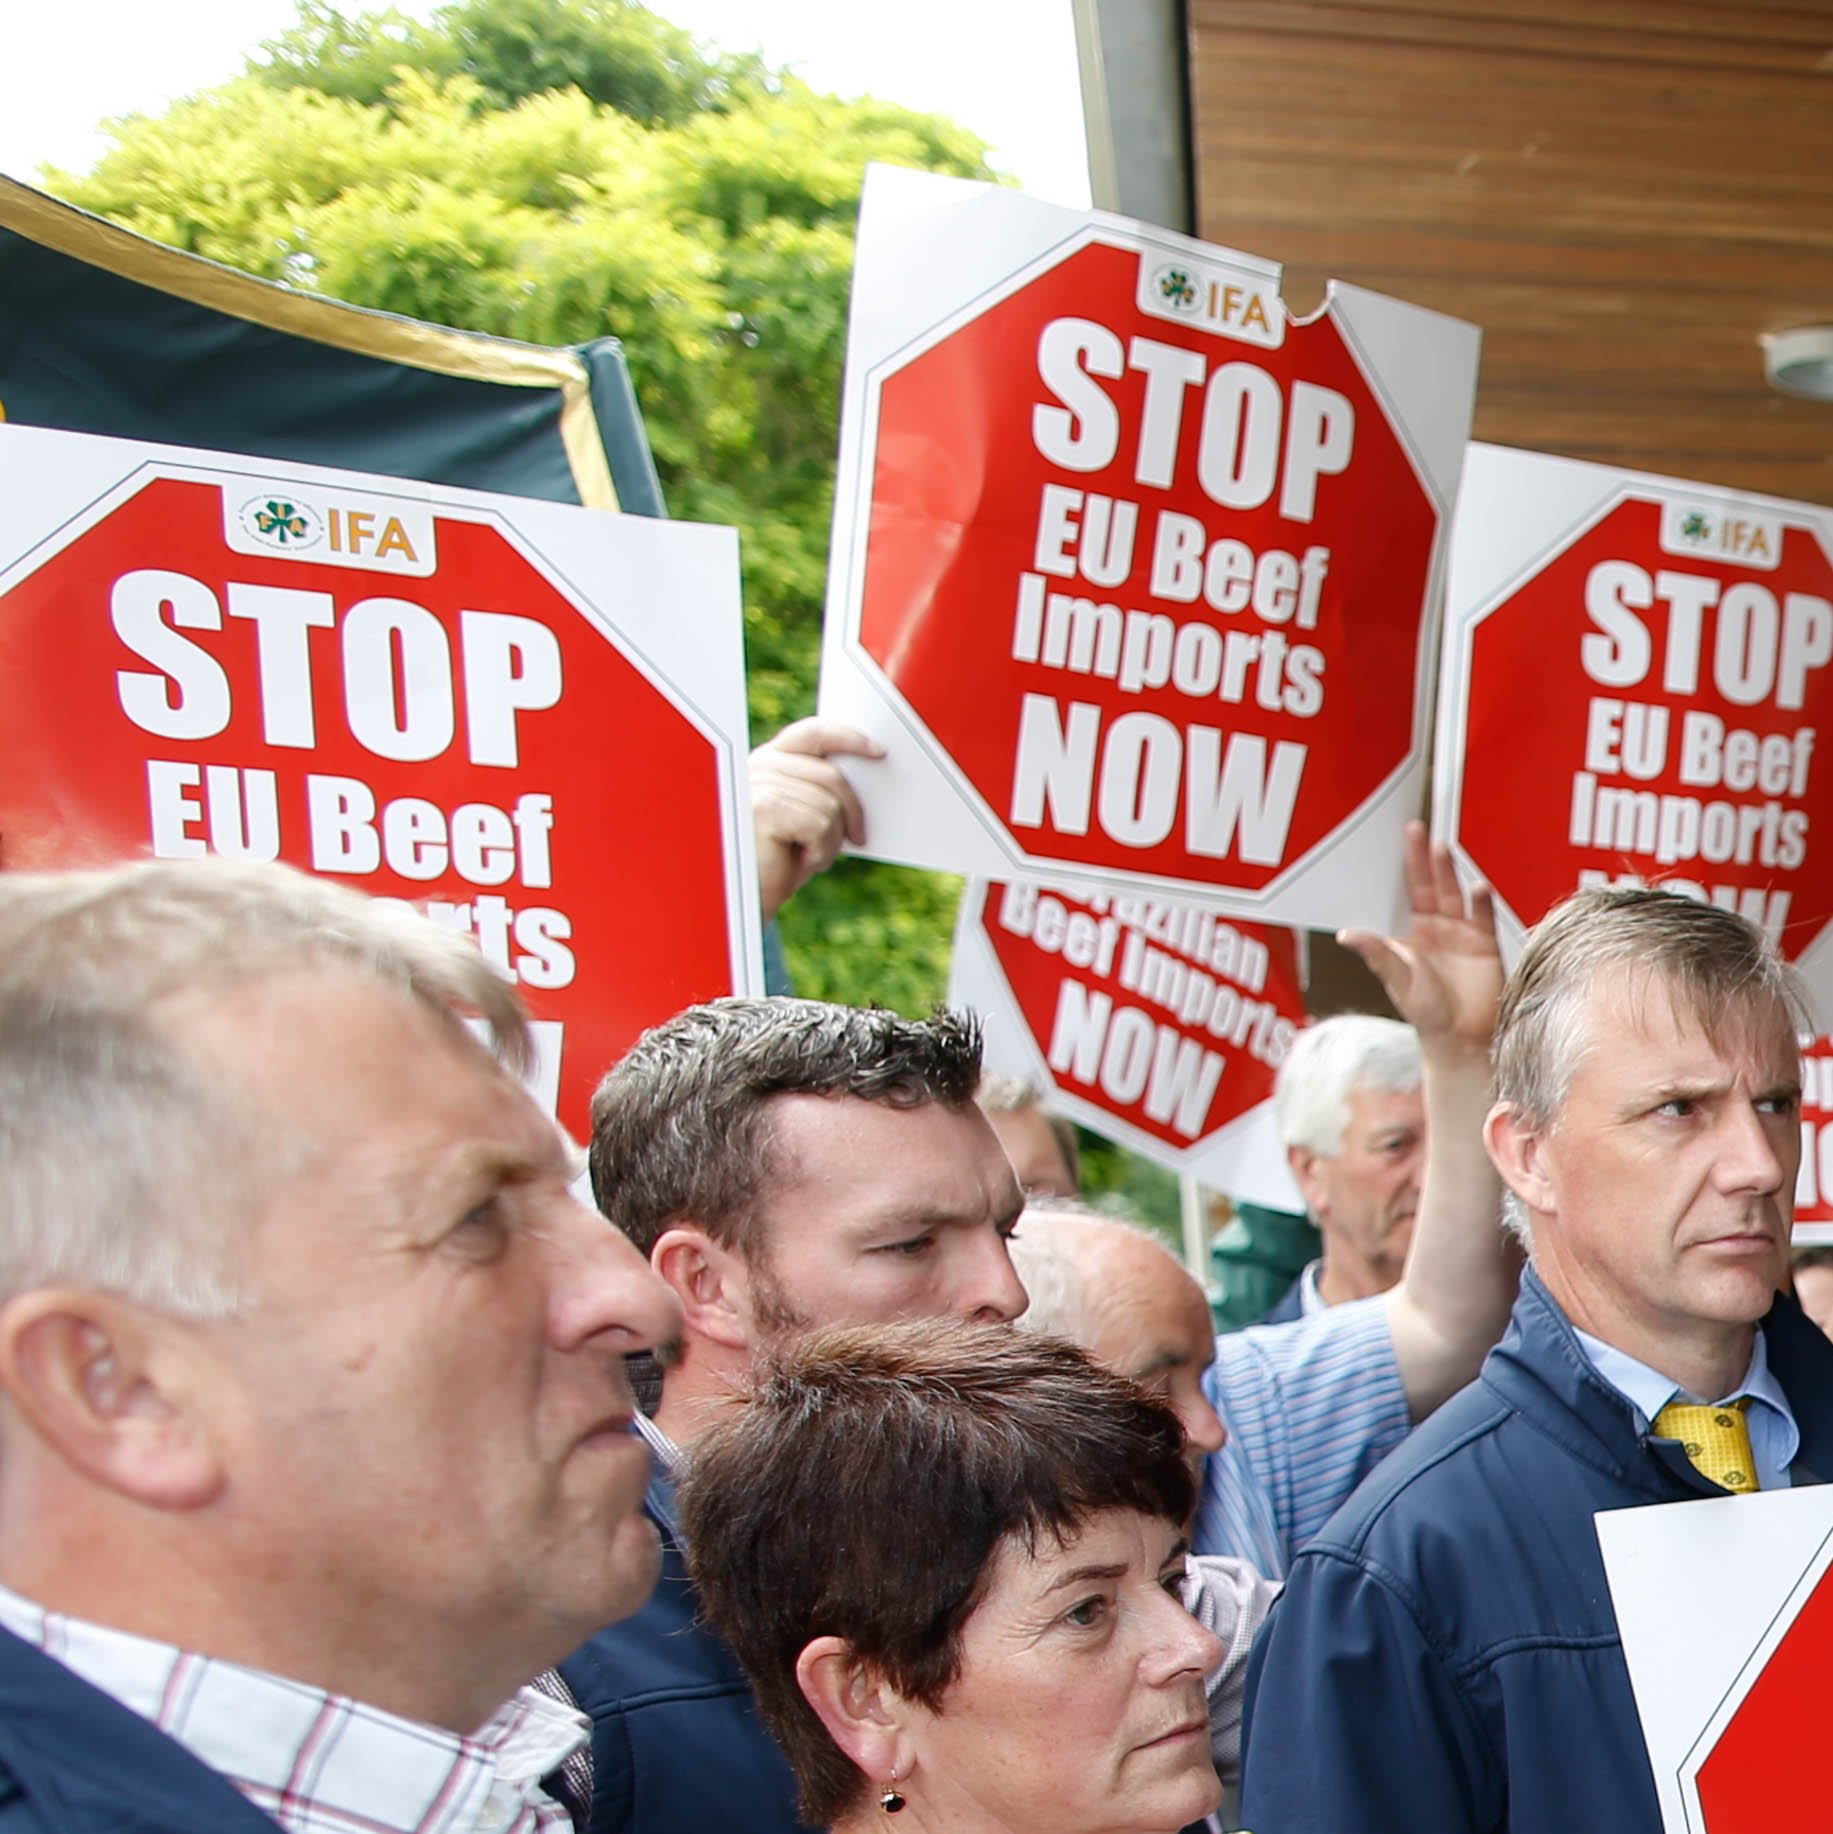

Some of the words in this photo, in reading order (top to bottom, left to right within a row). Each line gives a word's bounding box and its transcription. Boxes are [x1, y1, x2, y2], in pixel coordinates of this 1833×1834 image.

[1208, 284, 1271, 333] IFA
[1032, 316, 1355, 523] STOP
[328, 508, 419, 562] IFA
[1034, 483, 1139, 587] EU
[1150, 511, 1330, 629] Beef
[1721, 518, 1770, 556] IFA
[110, 568, 563, 768] STOP
[1011, 572, 1324, 718] Imports
[1010, 693, 1308, 867] NOW
[1585, 696, 1670, 779] EU
[1680, 710, 1816, 796] Beef
[146, 759, 281, 863] EU
[305, 773, 553, 889] Beef
[1569, 771, 1809, 870] Imports
[1050, 978, 1225, 1138] NOW
[1119, 927, 1297, 1070] Imports
